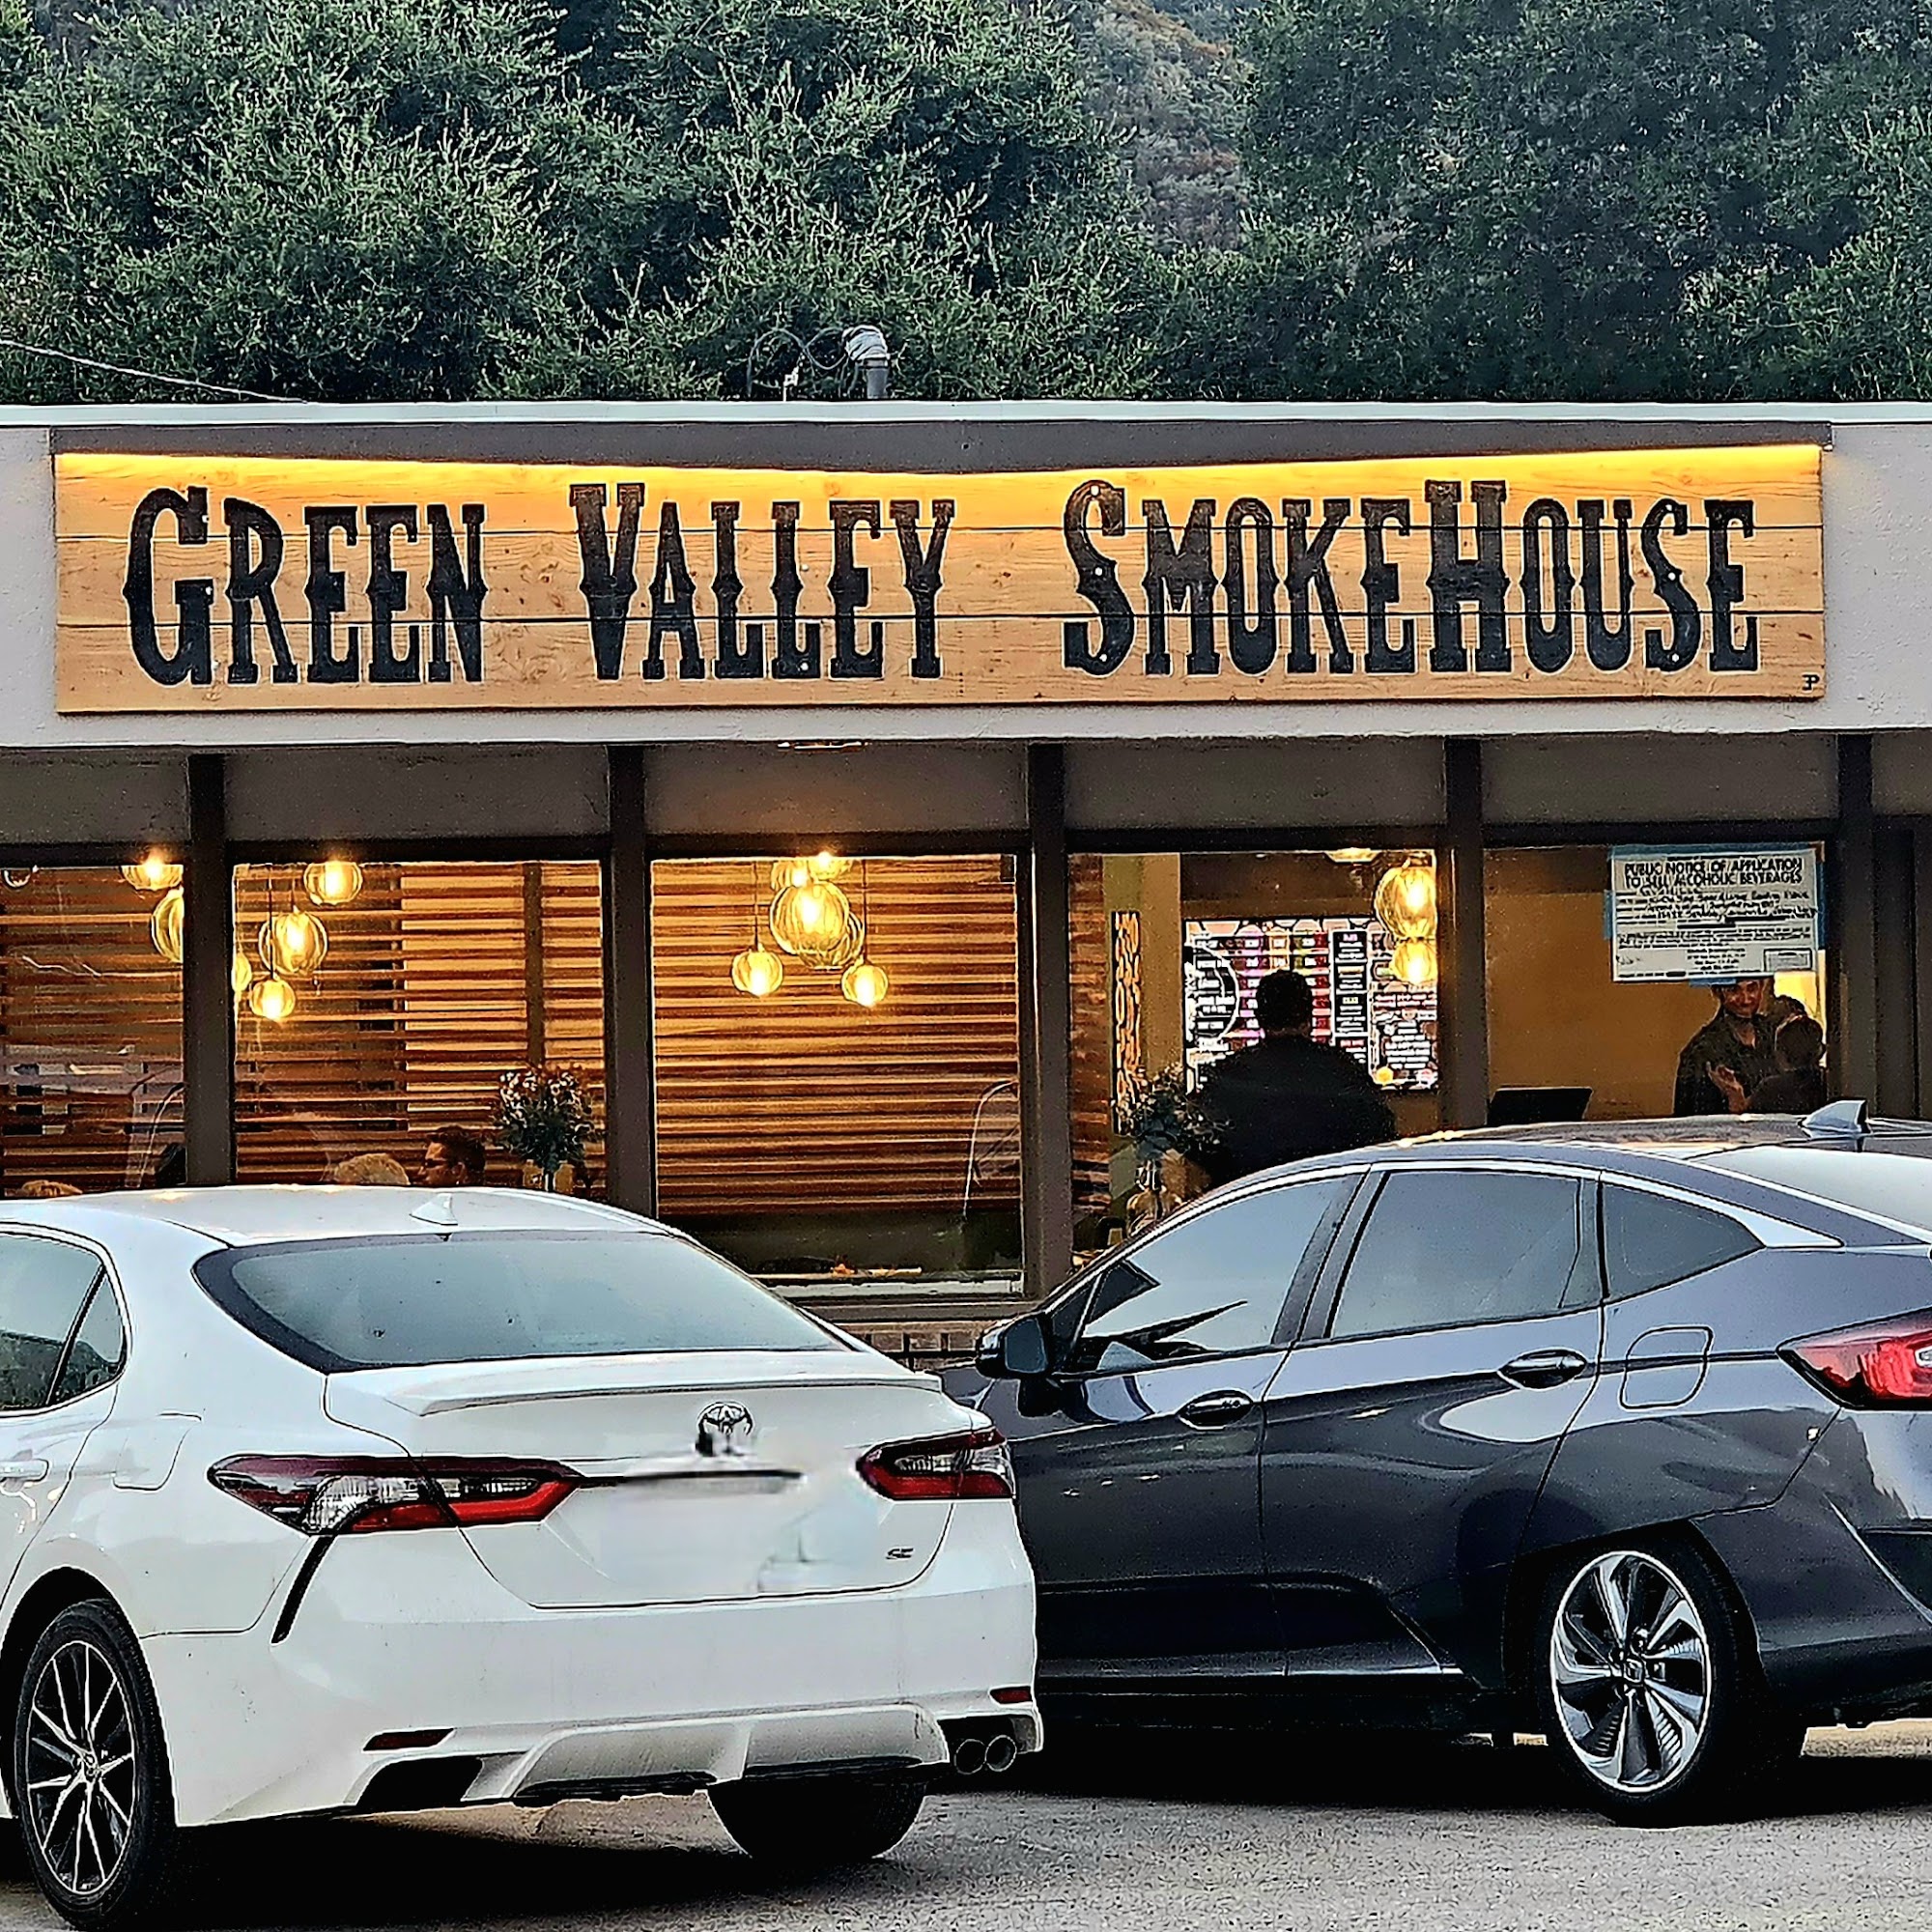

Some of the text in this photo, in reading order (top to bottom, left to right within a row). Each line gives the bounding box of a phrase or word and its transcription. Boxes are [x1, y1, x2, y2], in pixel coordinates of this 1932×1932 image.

[124, 479, 1758, 686] GREEN VALLEY SMOKEHOUSE
[1711, 859, 1726, 872] OF
[1625, 874, 1641, 889] TO
